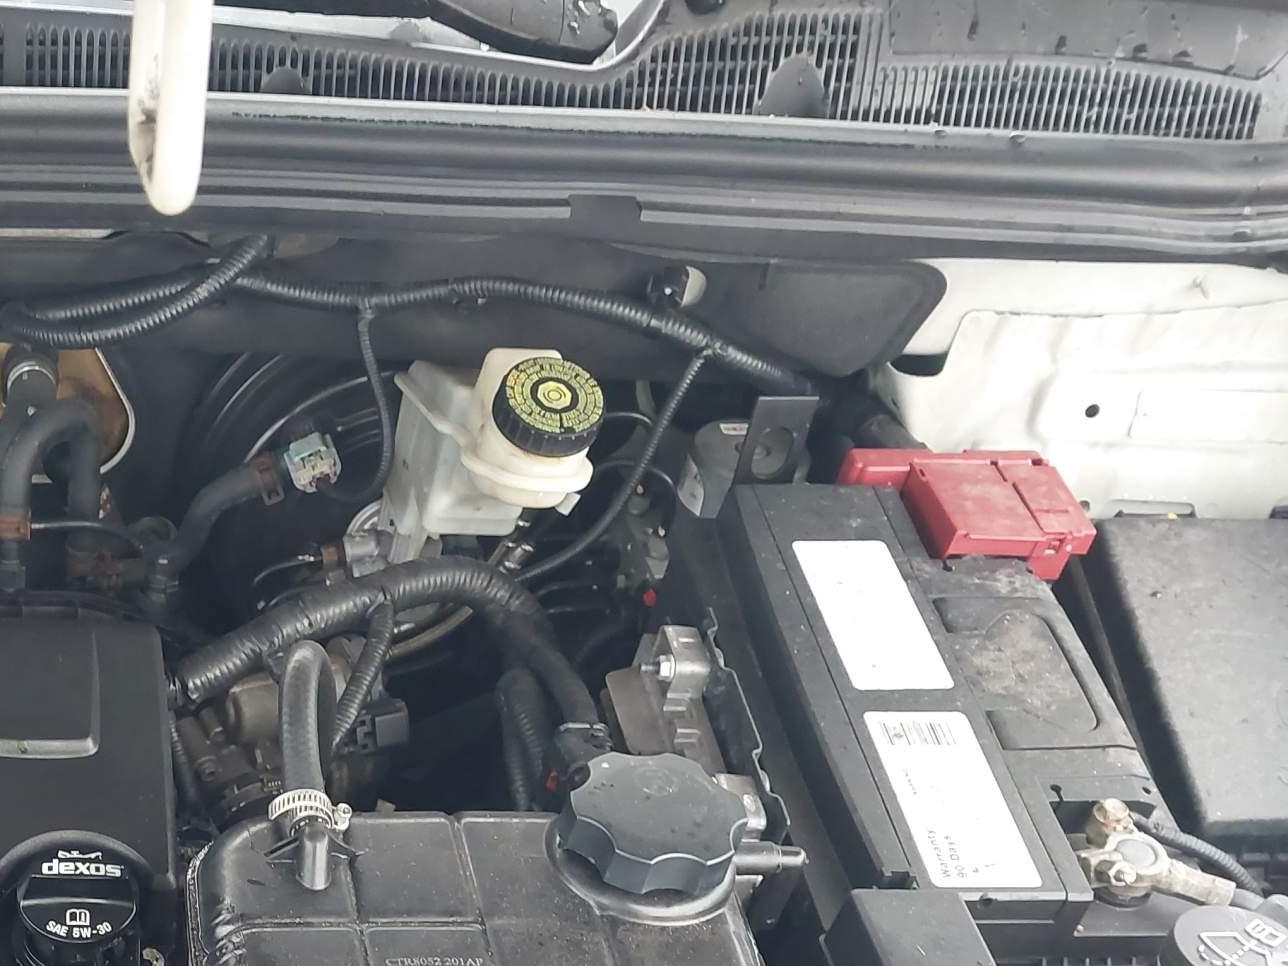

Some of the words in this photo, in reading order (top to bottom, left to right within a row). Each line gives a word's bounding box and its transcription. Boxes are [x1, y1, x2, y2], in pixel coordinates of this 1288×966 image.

[41, 858, 122, 877] dexos
[46, 920, 69, 937] SAE
[72, 921, 112, 939] 5W-30
